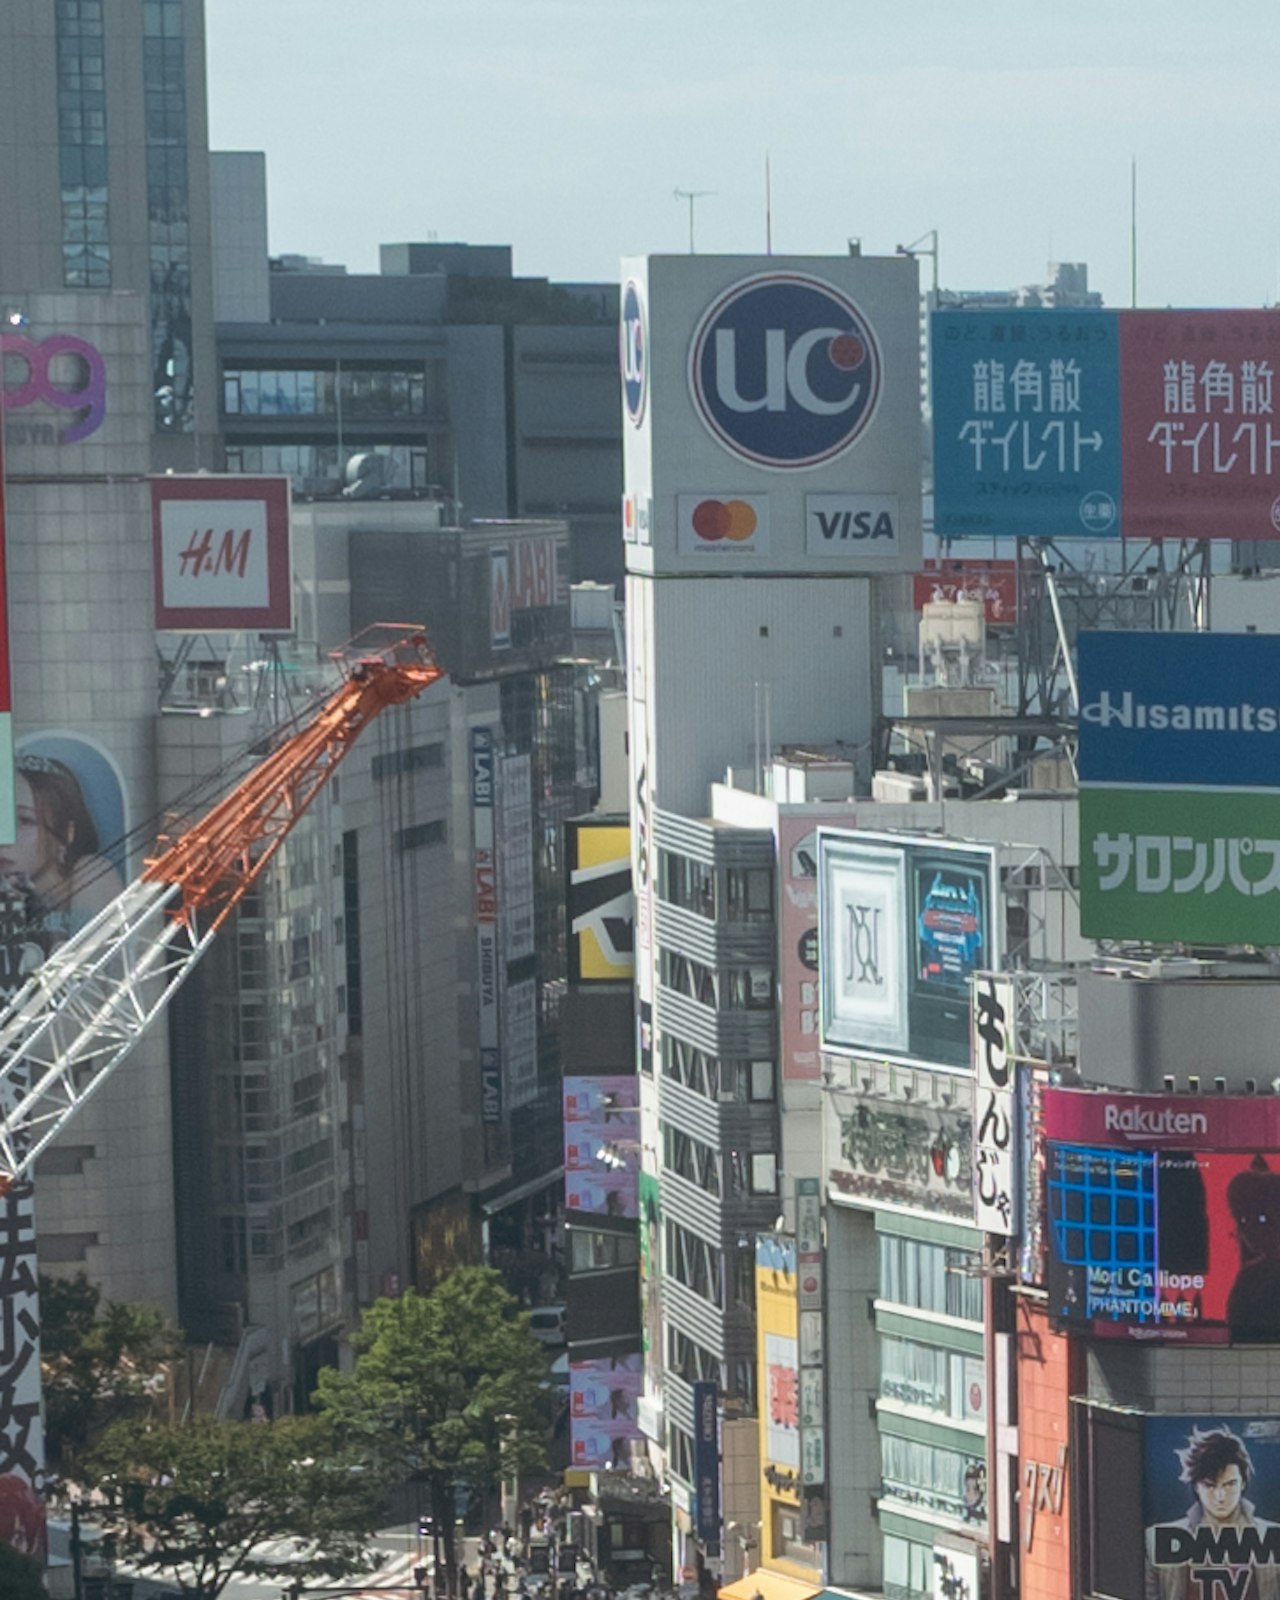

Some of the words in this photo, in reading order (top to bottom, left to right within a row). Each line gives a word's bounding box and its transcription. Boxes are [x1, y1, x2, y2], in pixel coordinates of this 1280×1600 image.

[973, 359, 1082, 414] 龍角散
[1163, 360, 1274, 415] 龍角散
[958, 421, 1104, 472] ダイレクト
[178, 528, 253, 579] H&M
[812, 512, 894, 541] VISA
[474, 752, 493, 809] LABI
[476, 864, 497, 926] LABI
[480, 936, 494, 1007] SHIBUYA
[1104, 1104, 1208, 1136] Rakuten
[1087, 1266, 1122, 1287] Mori
[1025, 1444, 1067, 1555] クスリ
